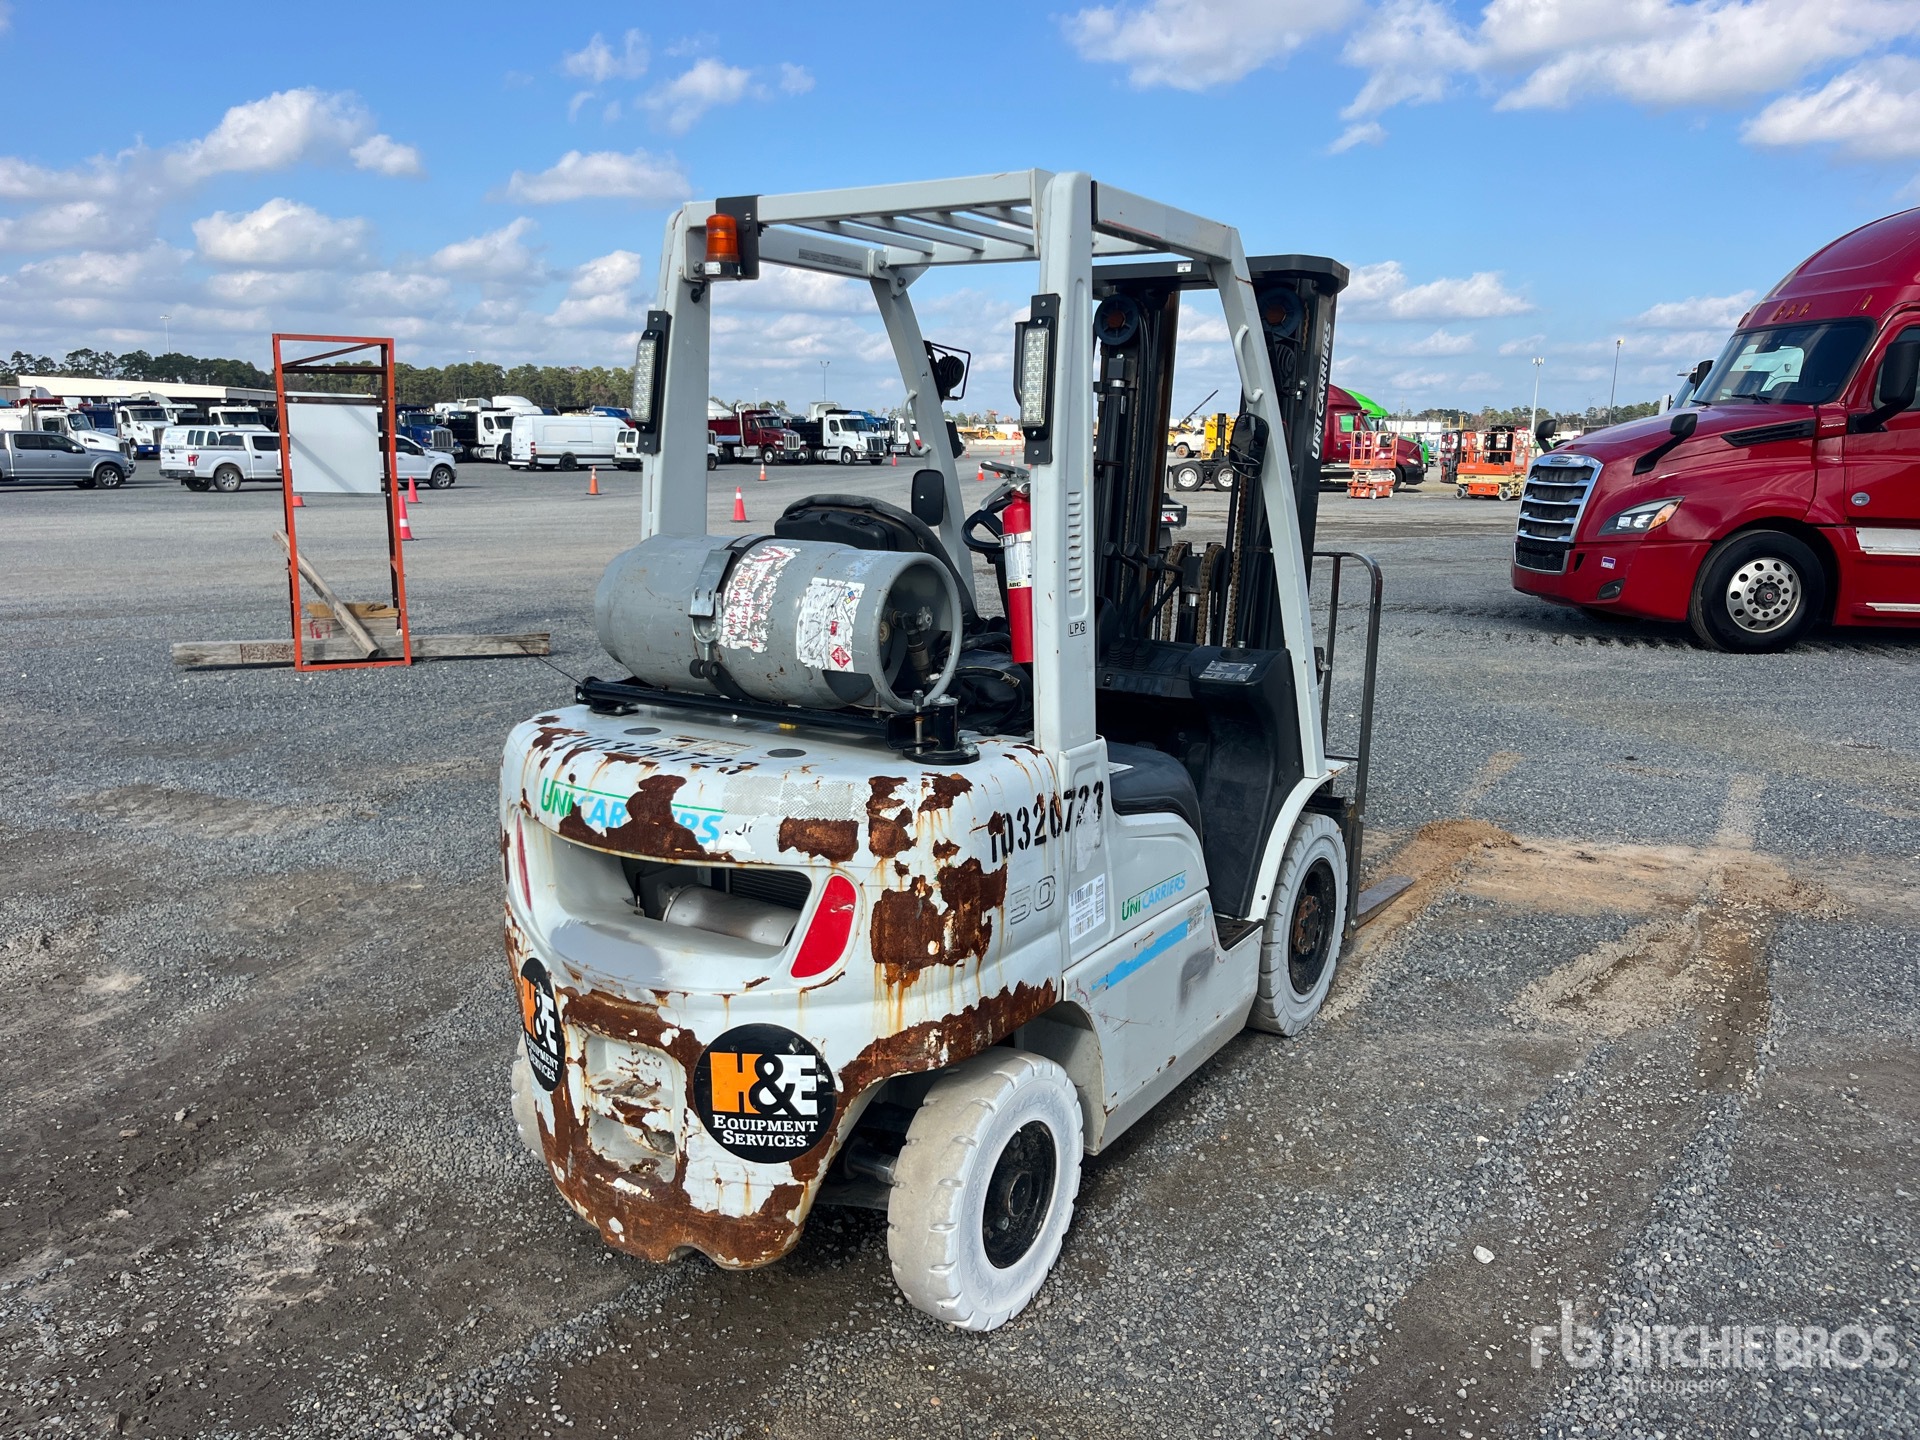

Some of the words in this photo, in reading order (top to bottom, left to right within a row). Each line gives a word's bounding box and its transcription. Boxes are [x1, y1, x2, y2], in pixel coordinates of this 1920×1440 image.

[1311, 320, 1332, 460] UNICARRIERS
[1069, 622, 1086, 635] LPG
[1121, 869, 1187, 921] UNICARRIERS
[709, 1051, 818, 1116] H&E
[712, 1114, 818, 1132] EQUIPMENT
